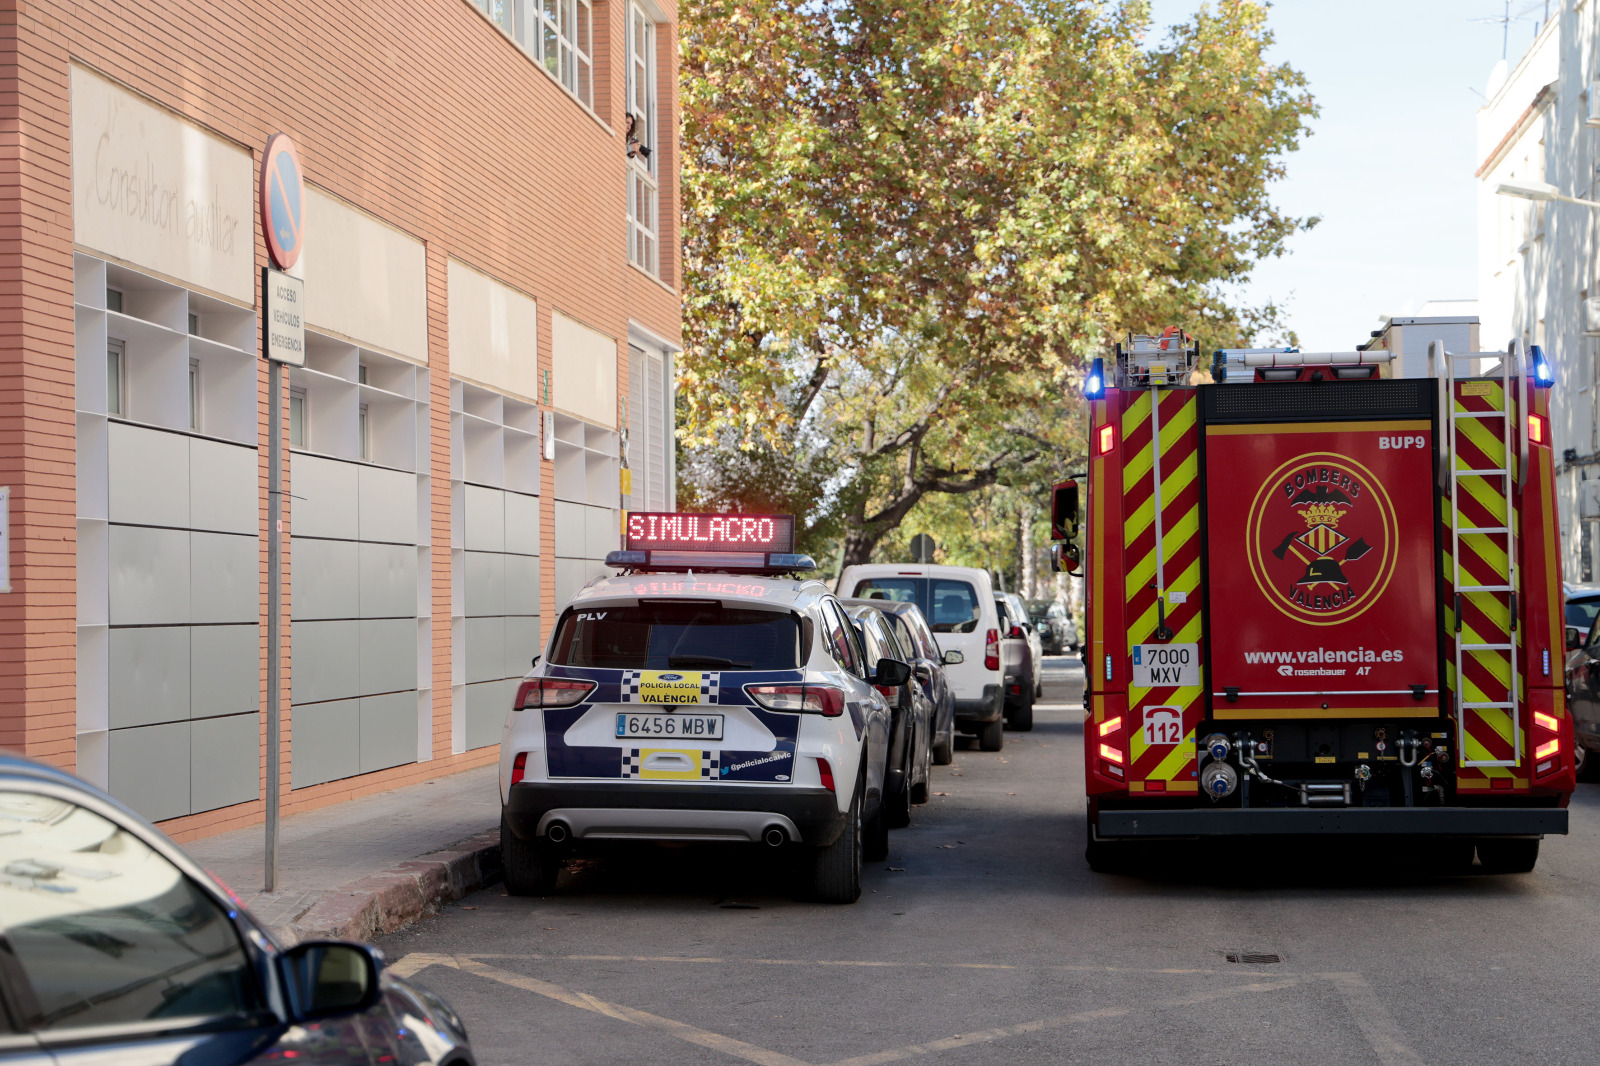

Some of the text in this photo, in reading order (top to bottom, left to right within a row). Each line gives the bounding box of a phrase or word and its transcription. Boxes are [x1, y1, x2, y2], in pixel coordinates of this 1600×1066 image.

[185, 183, 239, 256] auxiliar
[276, 285, 297, 303] ACCESO
[272, 308, 300, 328] VEHÍCULOS
[271, 332, 302, 352] EMERGENCIA
[1379, 436, 1425, 449] BUP9
[1284, 468, 1360, 499] BOMBERS
[629, 515, 774, 543] SIMULACRO
[577, 612, 607, 621] PLV
[1148, 649, 1189, 665] 7000
[1244, 647, 1404, 664] www.valencia.es
[1151, 667, 1181, 683] MXV
[1295, 667, 1371, 676] rosenbauer AT
[642, 693, 698, 703] VALÈNCIA
[629, 717, 717, 735] 6456 MBW
[1147, 722, 1180, 743] 112
